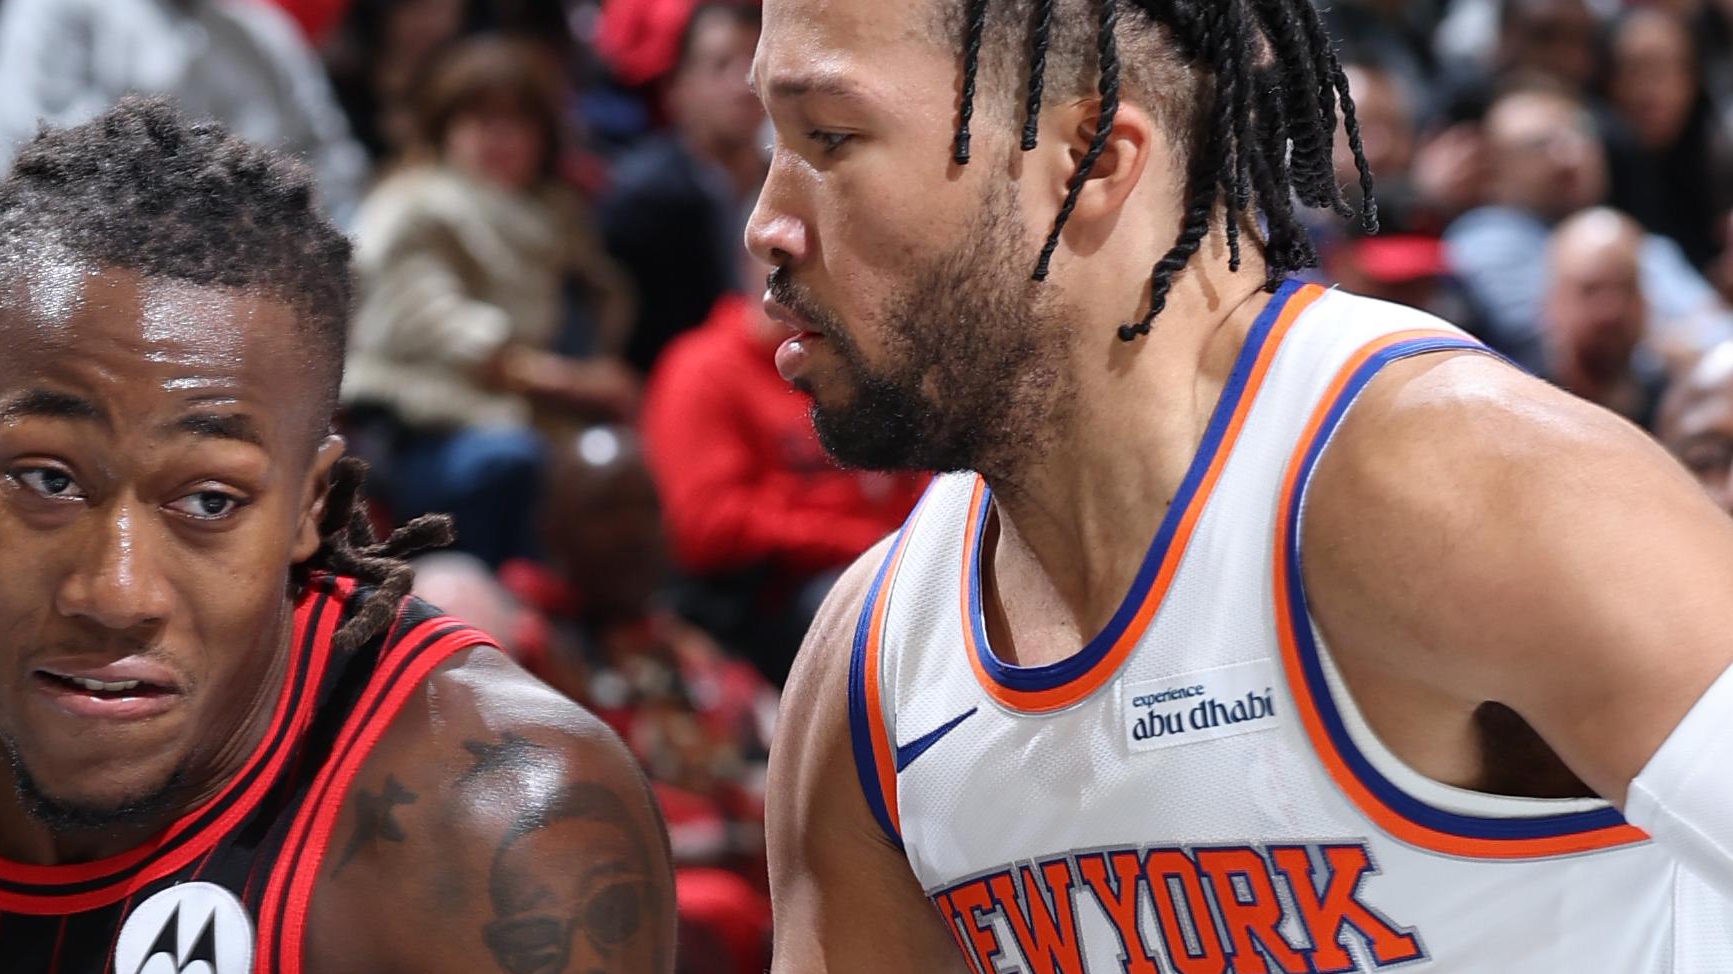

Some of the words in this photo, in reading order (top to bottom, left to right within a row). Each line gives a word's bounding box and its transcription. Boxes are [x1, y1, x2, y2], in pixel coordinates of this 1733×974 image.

[1132, 684, 1205, 708] experience
[1132, 710, 1184, 741] abu
[1189, 687, 1276, 730] dhabi
